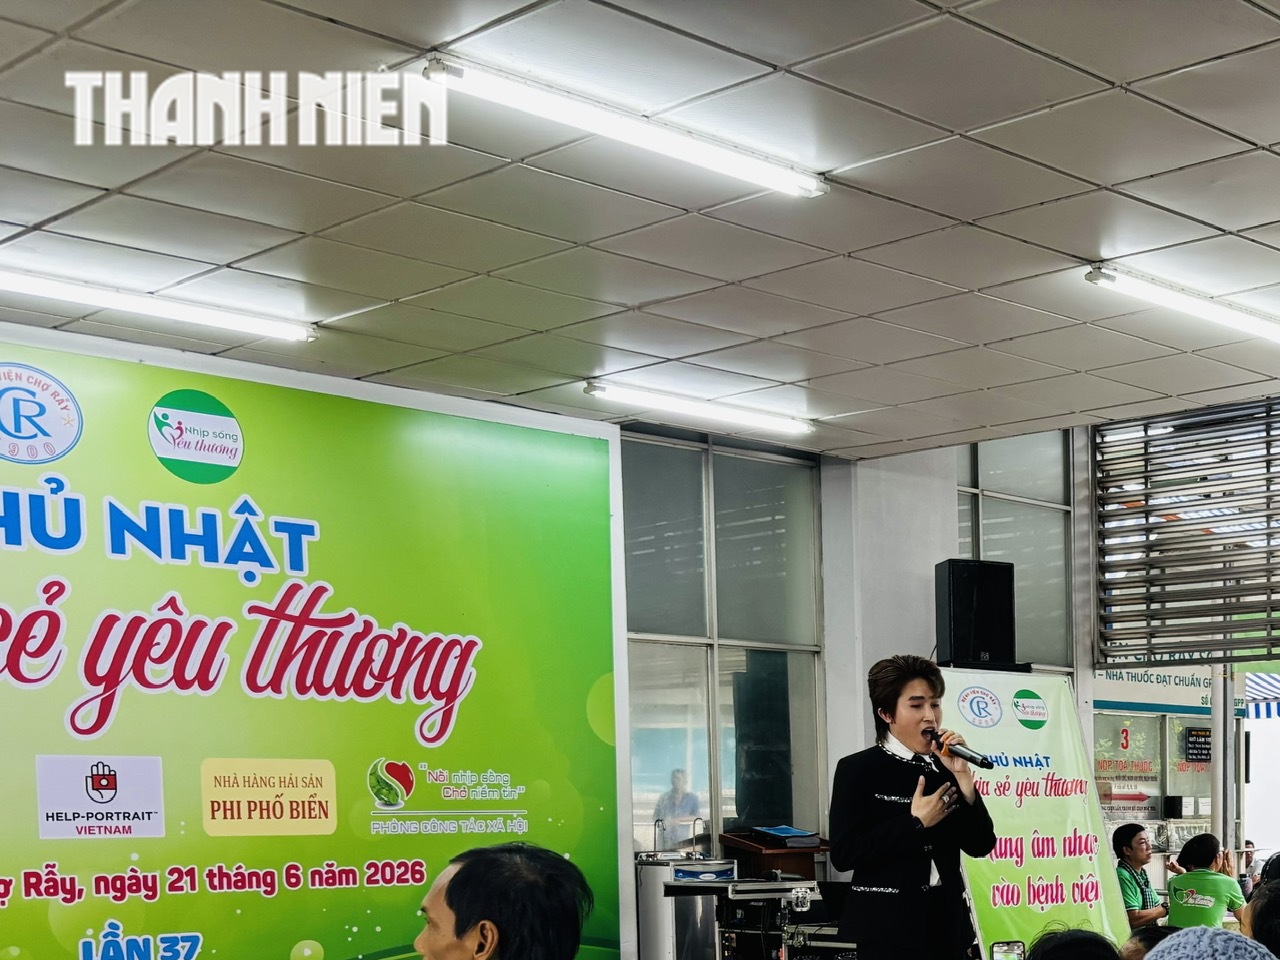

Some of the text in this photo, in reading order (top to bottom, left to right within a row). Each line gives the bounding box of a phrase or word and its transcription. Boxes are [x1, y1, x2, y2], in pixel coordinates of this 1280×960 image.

[0, 369, 22, 382] IỆN
[185, 426, 210, 438] Nhịp
[108, 498, 316, 583] NHẬT
[70, 596, 233, 736] yêu
[246, 582, 477, 744] thương
[1125, 669, 1154, 684] THUỐC
[1156, 676, 1173, 688] ĐẠT
[1173, 673, 1202, 689] CHUẨN
[1121, 728, 1130, 750] 3
[1013, 752, 1051, 771] NHẬT
[213, 772, 323, 789] NHÀ HÀNG HẢI SẢN
[1015, 777, 1040, 808] yêu
[210, 793, 329, 820] PHI PHỐ BIỂN
[75, 825, 132, 836] VIETNAM
[372, 818, 419, 834] PHÒNG
[421, 818, 457, 834] CÔNG
[488, 817, 505, 832] XÃ
[507, 817, 528, 835] HỘI
[989, 827, 1099, 868] ang âm nhạc
[23, 863, 84, 904] Rẫy,
[94, 867, 158, 902] ngày
[167, 866, 197, 893] 21
[206, 865, 276, 896] tháng
[284, 864, 302, 889] 6
[310, 862, 358, 888] năm
[365, 860, 426, 886] 2026
[991, 876, 1021, 908] vào
[1026, 874, 1067, 912] bệnh
